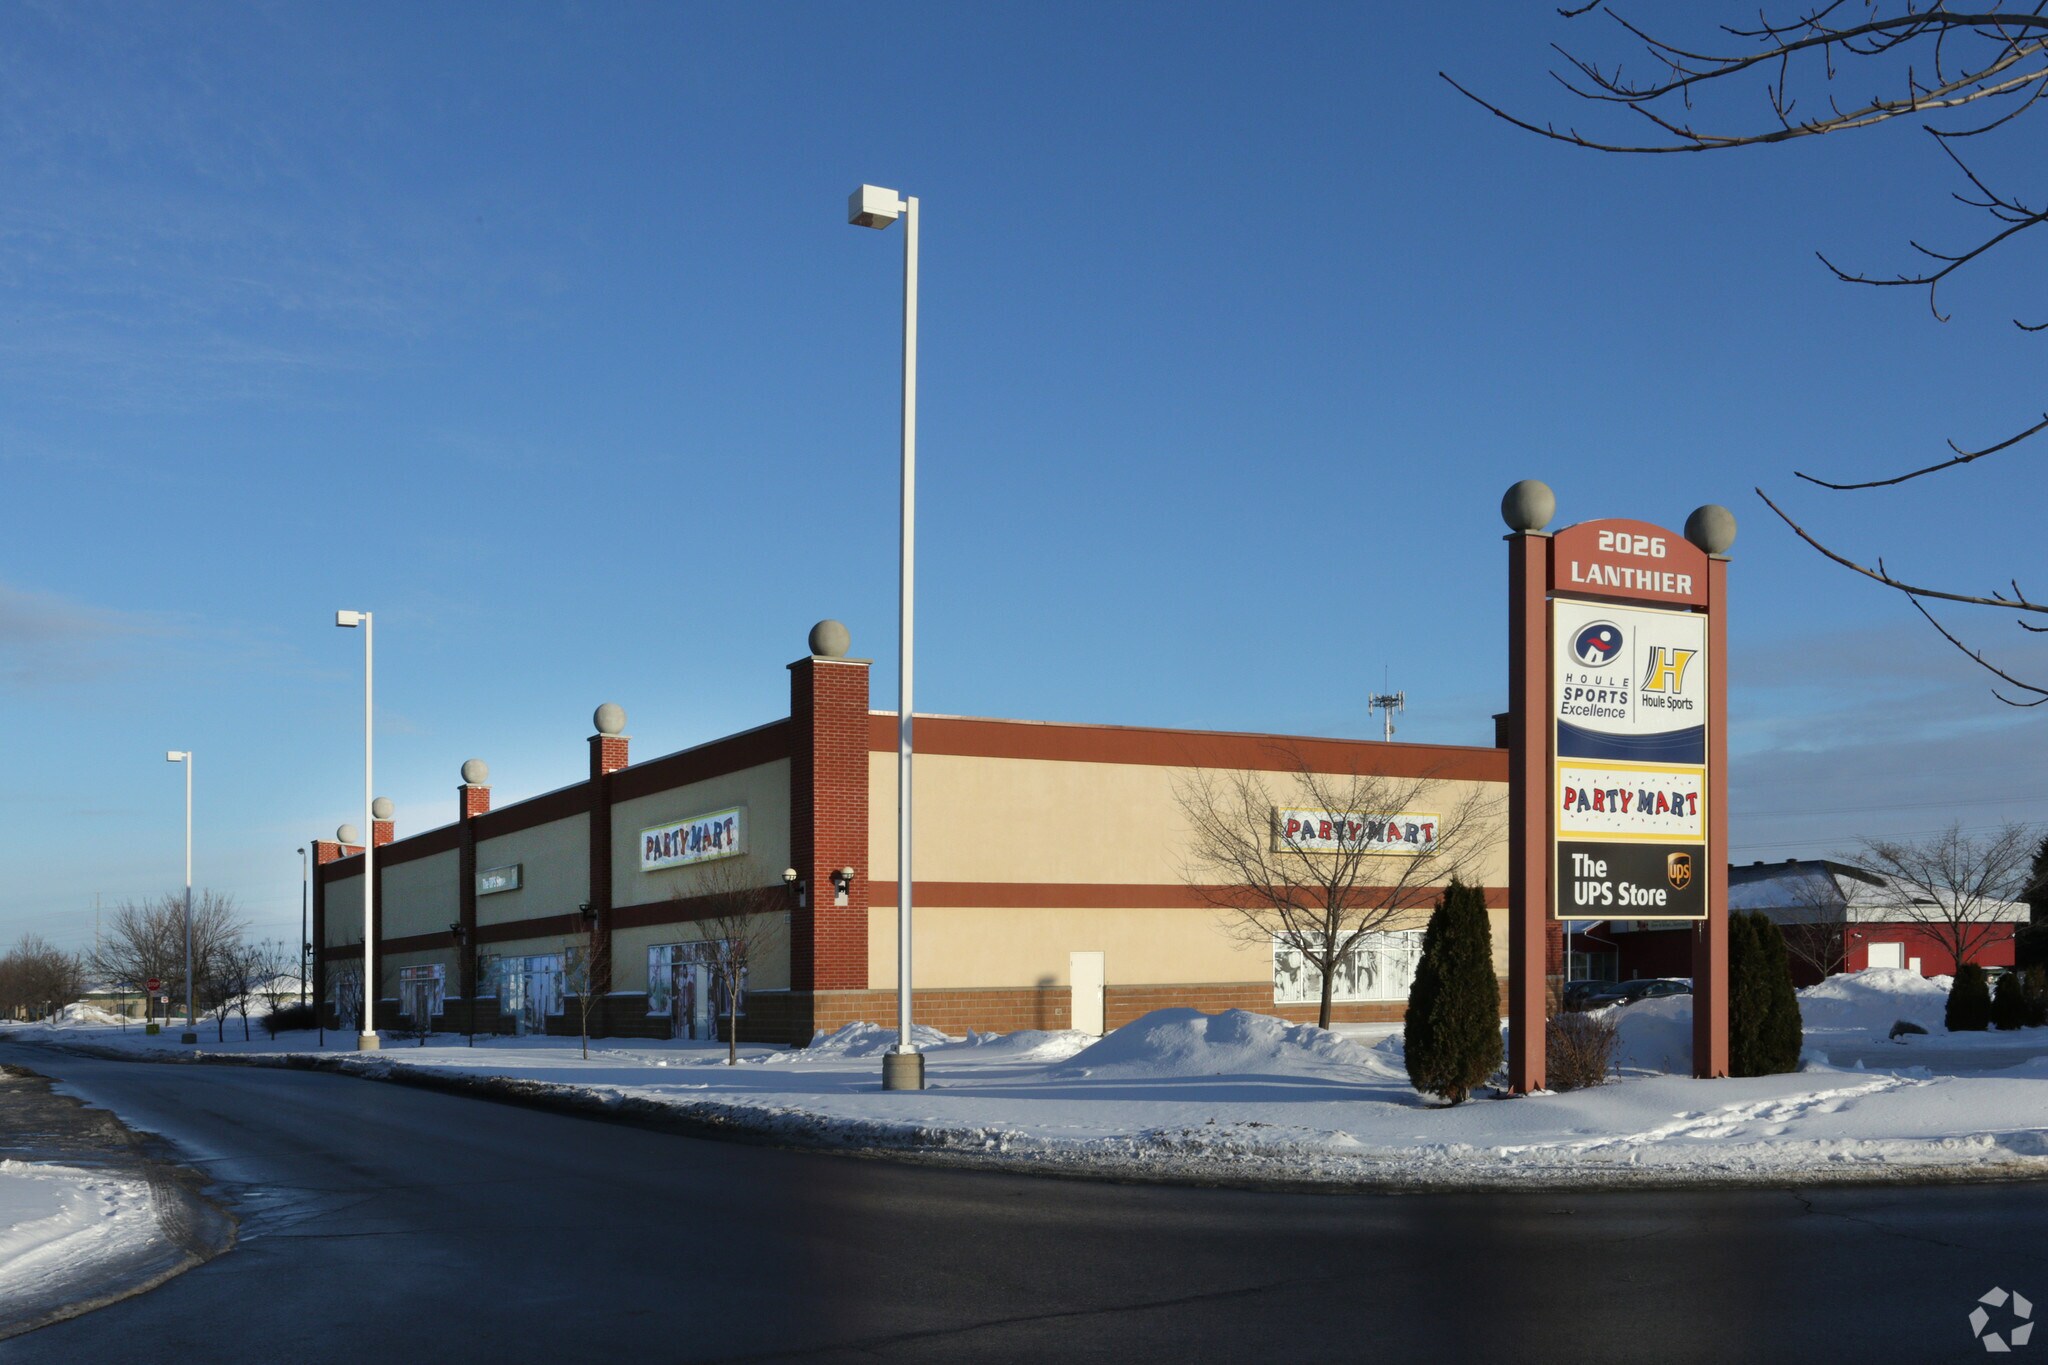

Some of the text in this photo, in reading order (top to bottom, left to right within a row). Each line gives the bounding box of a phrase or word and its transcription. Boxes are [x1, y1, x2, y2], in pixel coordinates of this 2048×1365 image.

[1599, 530, 1666, 558] 2026
[1571, 561, 1692, 595] LANTHIER
[1566, 673, 1629, 687] HOULE
[1563, 687, 1628, 704] SPORTS
[1642, 694, 1693, 711] Houle Sports
[1561, 702, 1626, 718] Excellence
[1563, 786, 1698, 817] PARTY MART
[645, 817, 733, 861] PARTY MART
[1286, 818, 1434, 844] PARTY MART
[1572, 853, 1607, 877] The
[1669, 864, 1690, 884] ups
[1574, 881, 1667, 906] UPS Store
